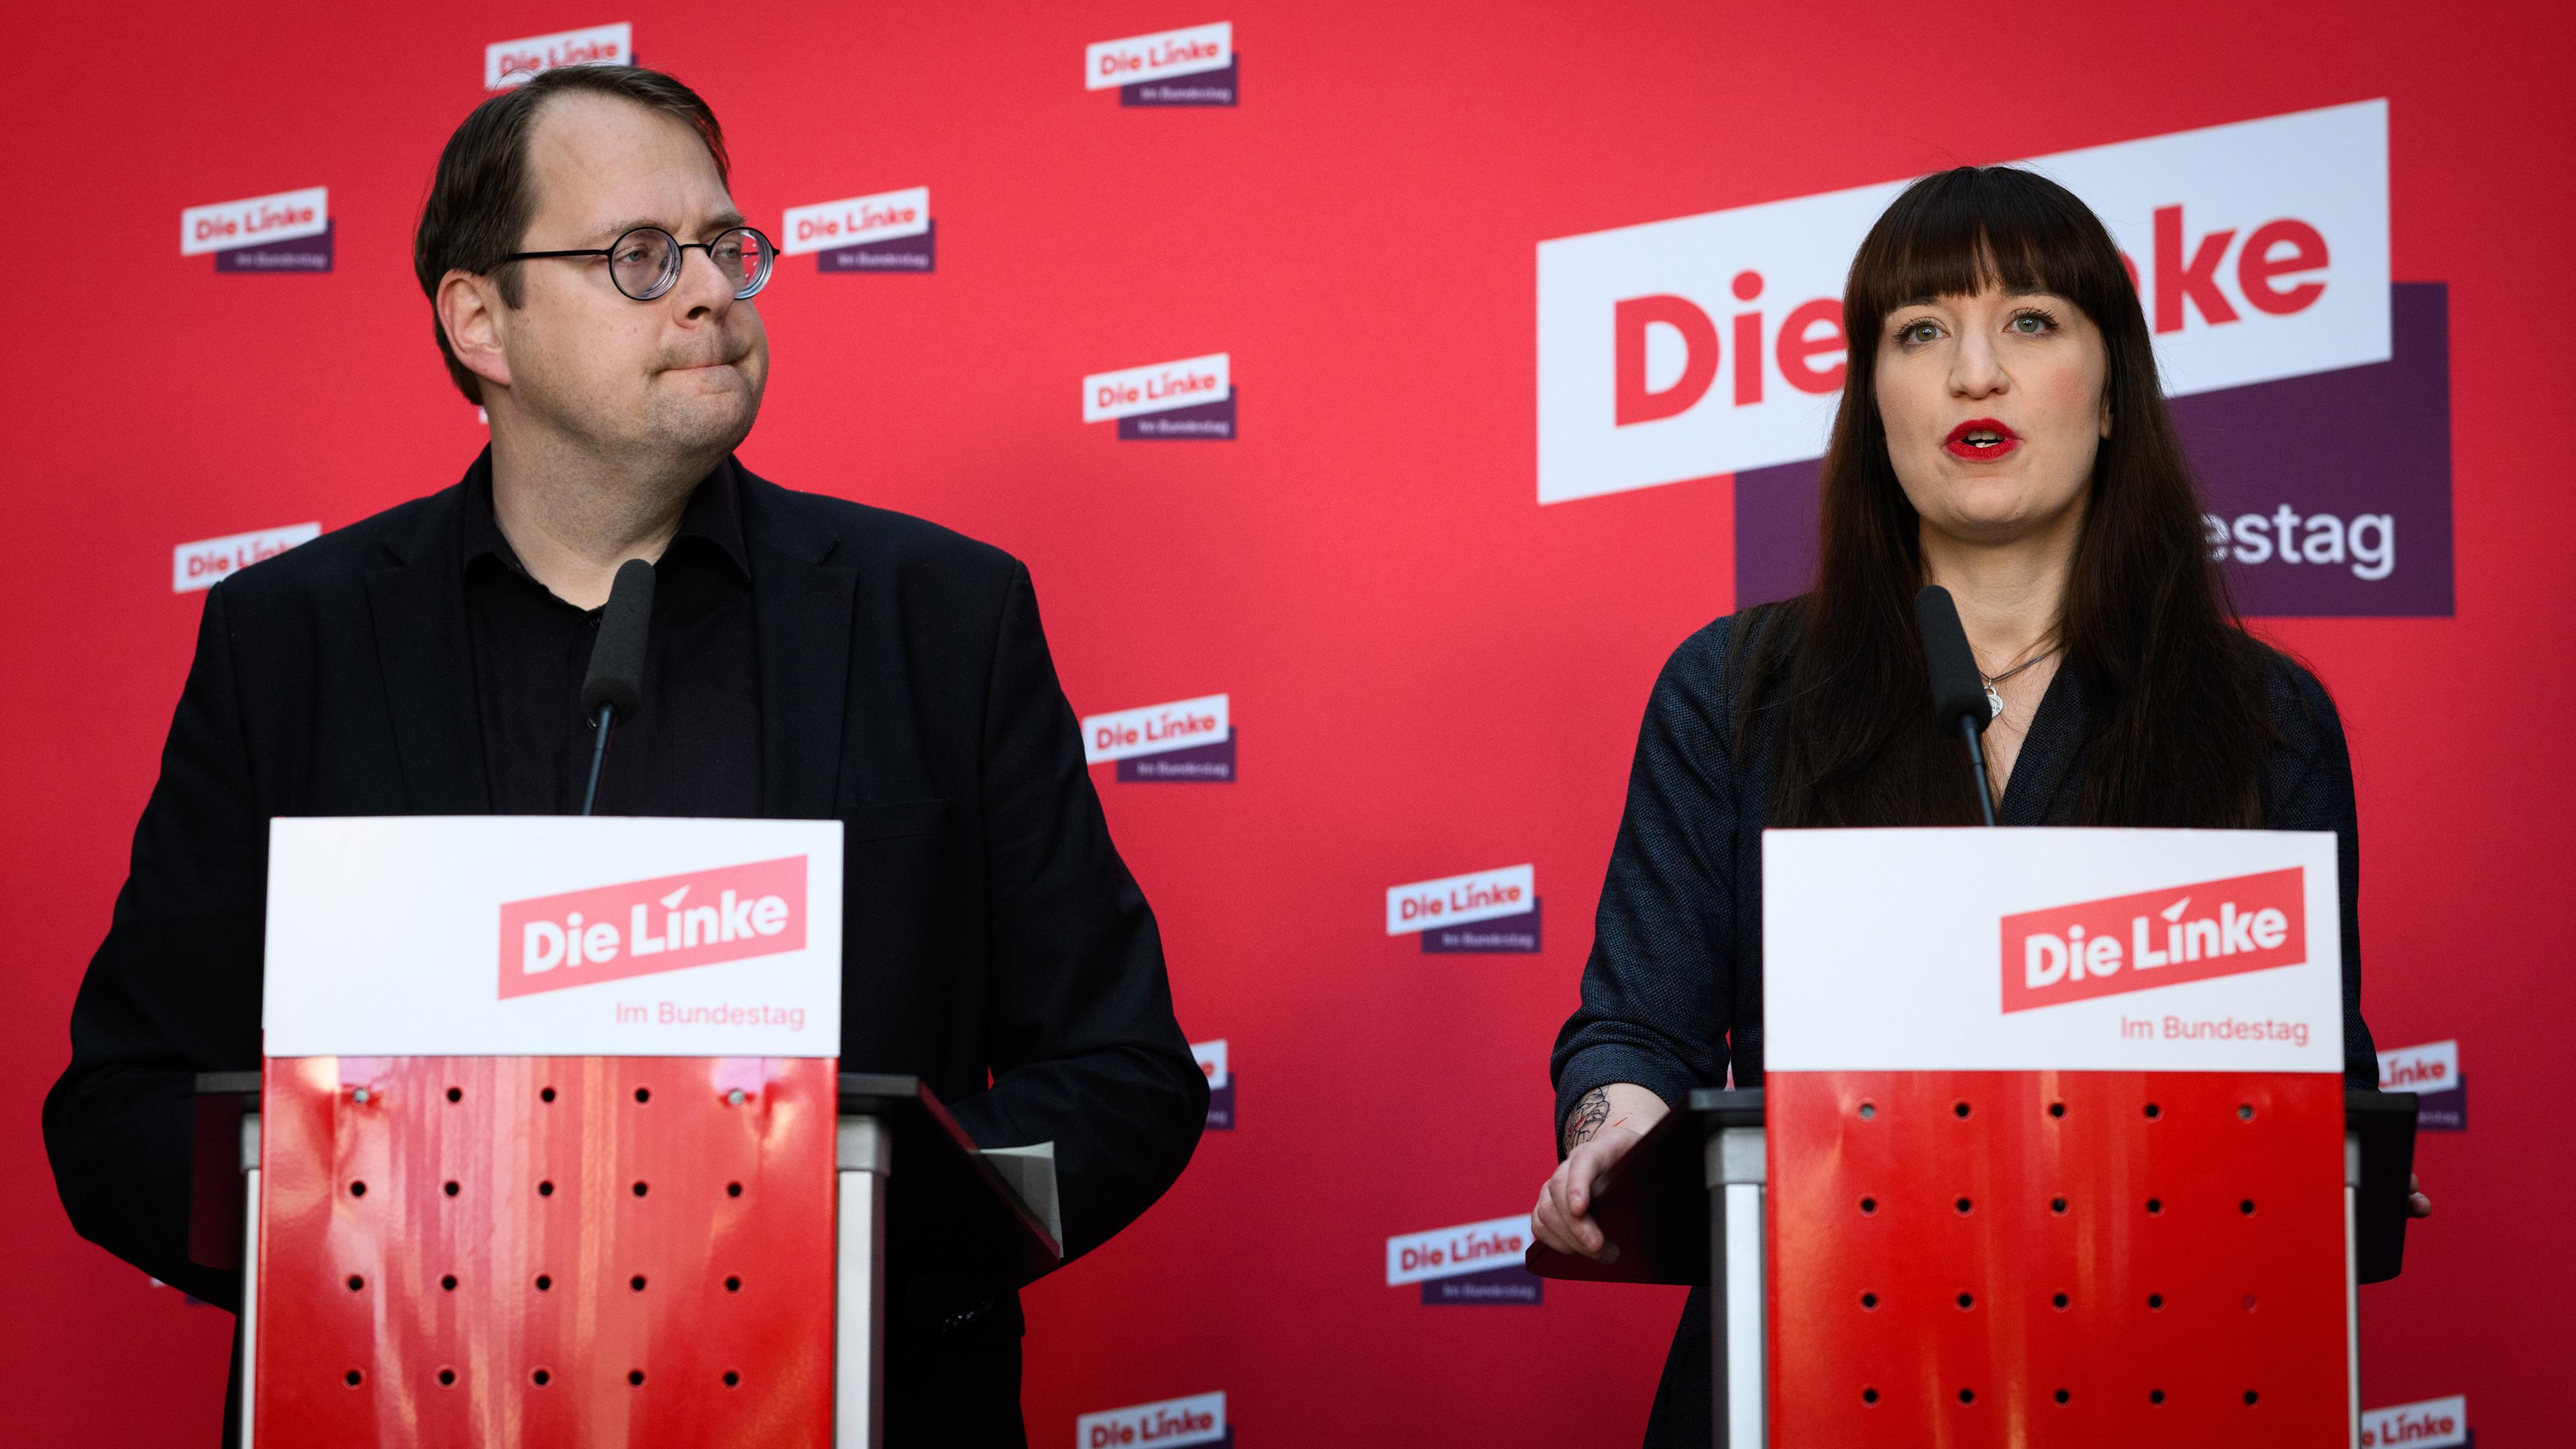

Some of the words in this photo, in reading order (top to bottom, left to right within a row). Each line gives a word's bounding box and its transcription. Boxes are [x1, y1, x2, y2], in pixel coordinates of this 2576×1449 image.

[500, 50, 541, 75] Die
[1100, 50, 1142, 76] Die
[1148, 39, 1218, 68] Linke
[196, 214, 237, 241] Die
[244, 204, 313, 233] Linke
[798, 214, 839, 241] Die
[846, 204, 916, 233] Linke
[1615, 269, 1847, 428] Die
[1098, 380, 1139, 409] Die
[1146, 371, 1216, 400] Linke
[2200, 503, 2395, 580] estag
[188, 550, 229, 578] Die
[1097, 722, 1138, 751] Die
[1146, 710, 1216, 741] Linke
[1401, 893, 1443, 921] Die
[1451, 881, 1521, 912] Linke
[523, 911, 620, 975] Die
[630, 884, 788, 957] Linke
[2025, 924, 2123, 989] Die
[2132, 896, 2288, 971] Linke
[616, 1002, 648, 1024] Im
[658, 1002, 805, 1032] Bundestag
[2122, 1016, 2153, 1038] Im
[2163, 1016, 2308, 1046] Bundestag
[1401, 1243, 1444, 1272] Die
[1451, 1231, 1522, 1263] Linke
[1091, 1419, 1135, 1448] Die
[1141, 1407, 1213, 1442] Linke
[2381, 1412, 2454, 1446] Linke
